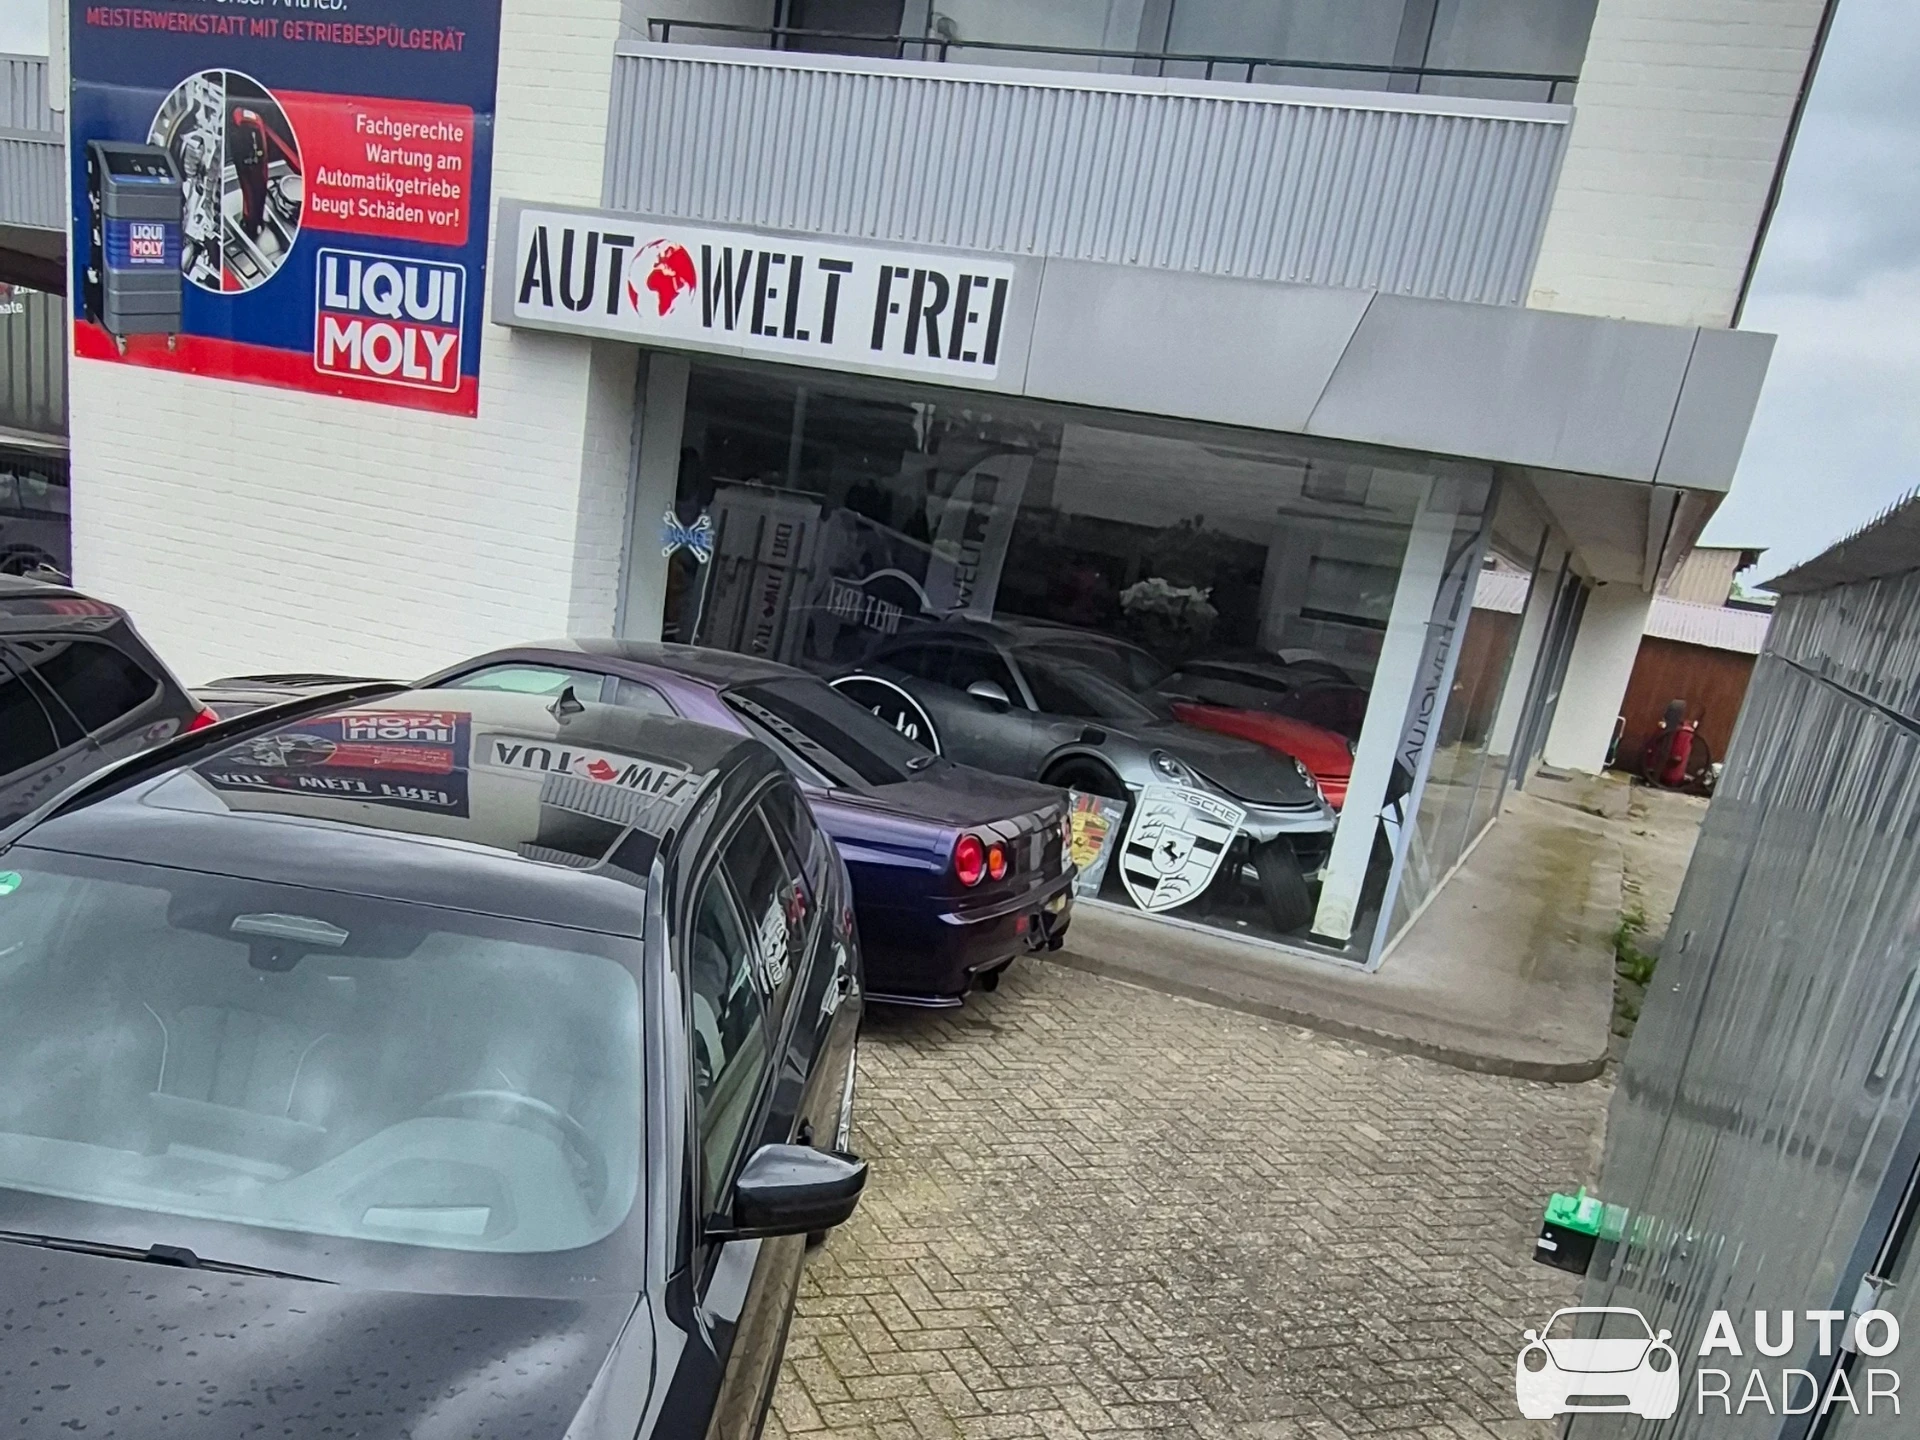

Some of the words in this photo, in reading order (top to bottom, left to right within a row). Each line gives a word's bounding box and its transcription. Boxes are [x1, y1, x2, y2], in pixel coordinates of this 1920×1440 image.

[86, 7, 245, 36] MEISTERWERKSTATT
[249, 18, 279, 38] MIT
[282, 20, 466, 52] GETRIEBESPÜLGERÄT
[356, 113, 464, 142] Fachgerechte
[366, 143, 433, 172] Wartung
[436, 154, 462, 171] am
[316, 166, 461, 199] Automatikgetriebe
[311, 192, 354, 219] beugt
[358, 198, 424, 223] Schäden
[427, 208, 460, 227] vor!
[132, 225, 163, 240] LIQUI
[132, 240, 164, 255] MOLY
[325, 253, 458, 323] LIQUI
[870, 264, 1011, 367] FREI
[321, 318, 459, 383] MOLY
